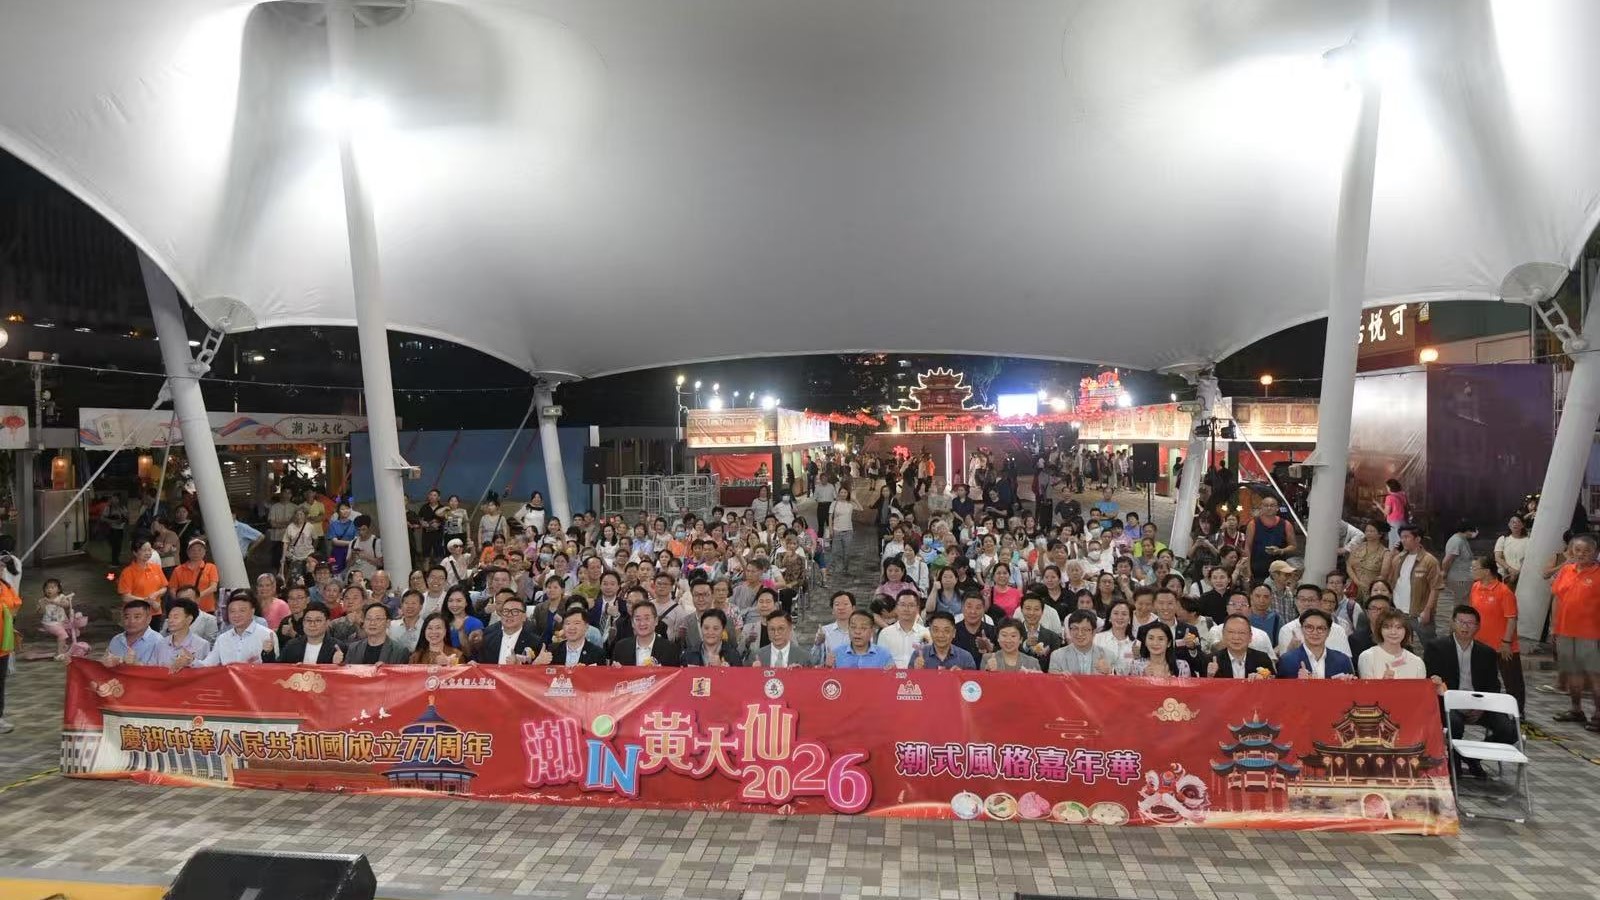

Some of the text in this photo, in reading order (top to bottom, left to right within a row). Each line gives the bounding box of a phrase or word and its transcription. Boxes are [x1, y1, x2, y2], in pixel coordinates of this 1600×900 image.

[291, 421, 344, 436] 潮汕文化
[119, 724, 493, 764] 慶祝中華人民共和國成立77周年
[895, 742, 1141, 785] 潮式風格嘉年華
